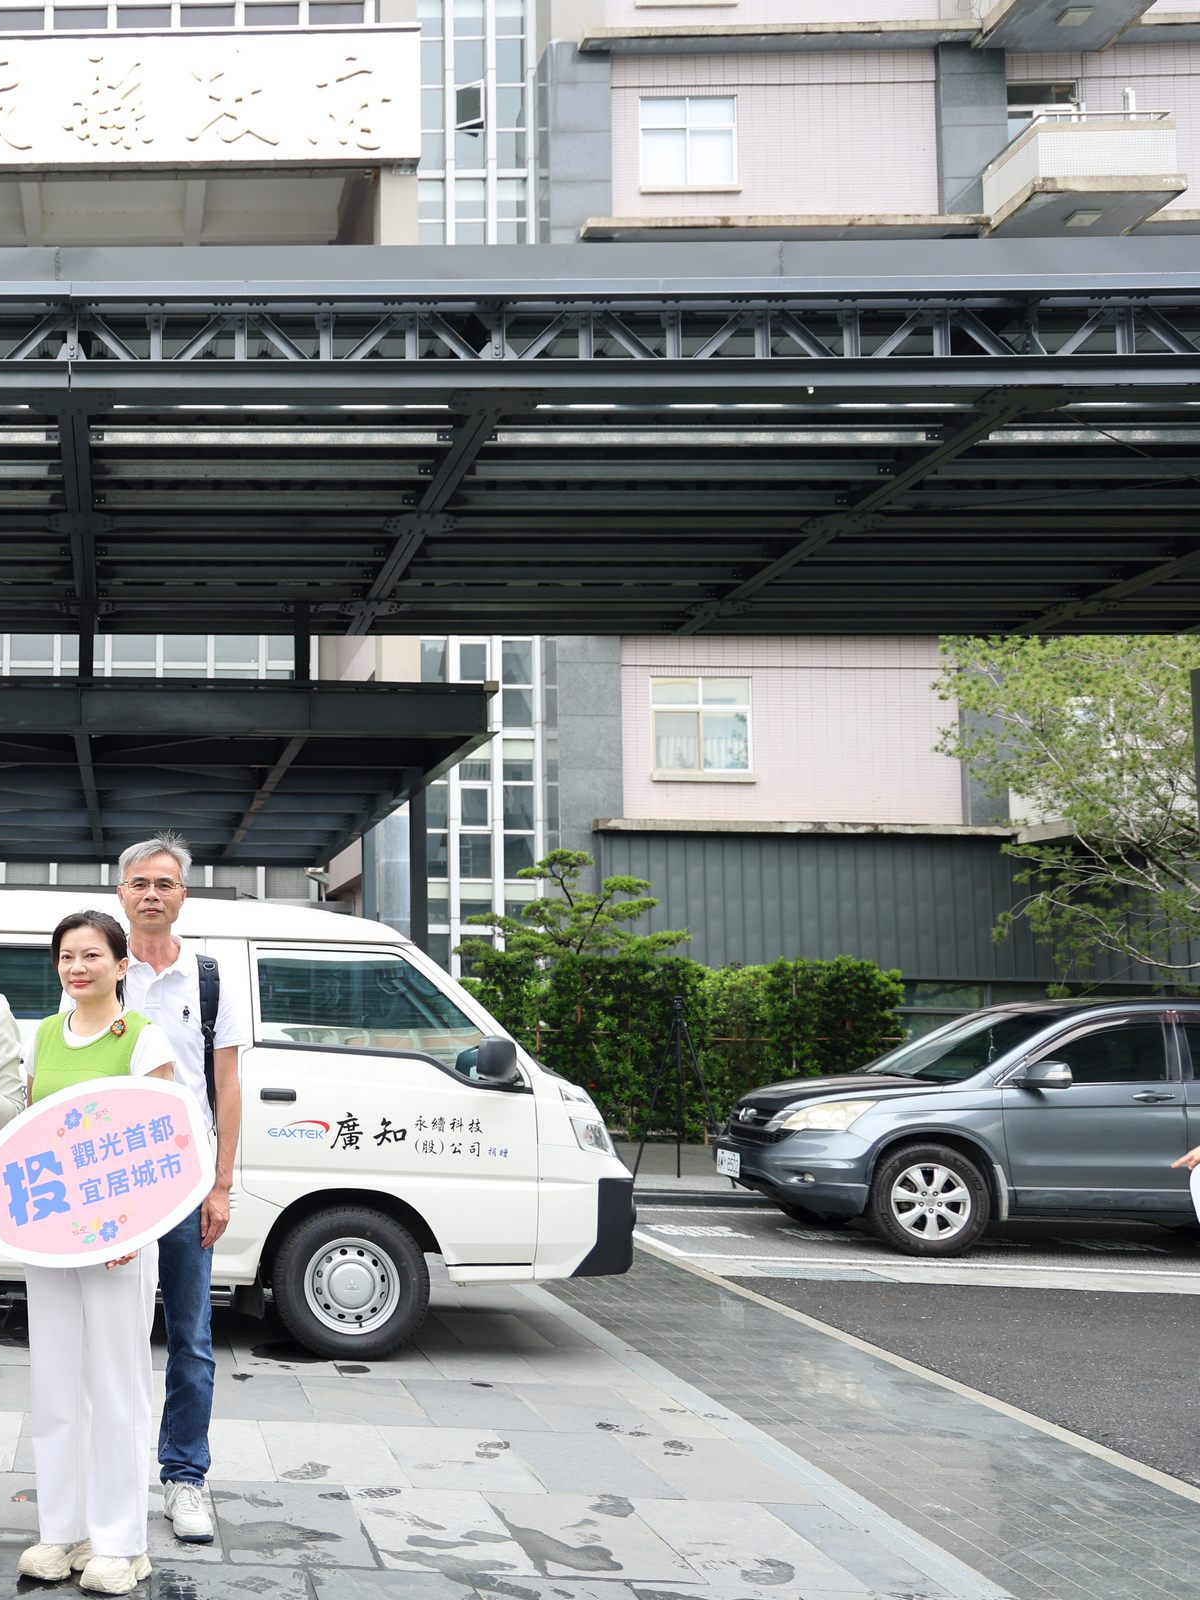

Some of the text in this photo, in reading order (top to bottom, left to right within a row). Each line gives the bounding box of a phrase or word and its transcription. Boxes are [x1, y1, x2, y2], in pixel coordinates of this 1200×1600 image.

[71, 1114, 175, 1170] 觀光首都
[267, 1127, 324, 1140] EAXTEK
[330, 1112, 407, 1151] 廣知
[414, 1115, 483, 1134] 永續科技
[79, 1152, 182, 1206] 宜居城市
